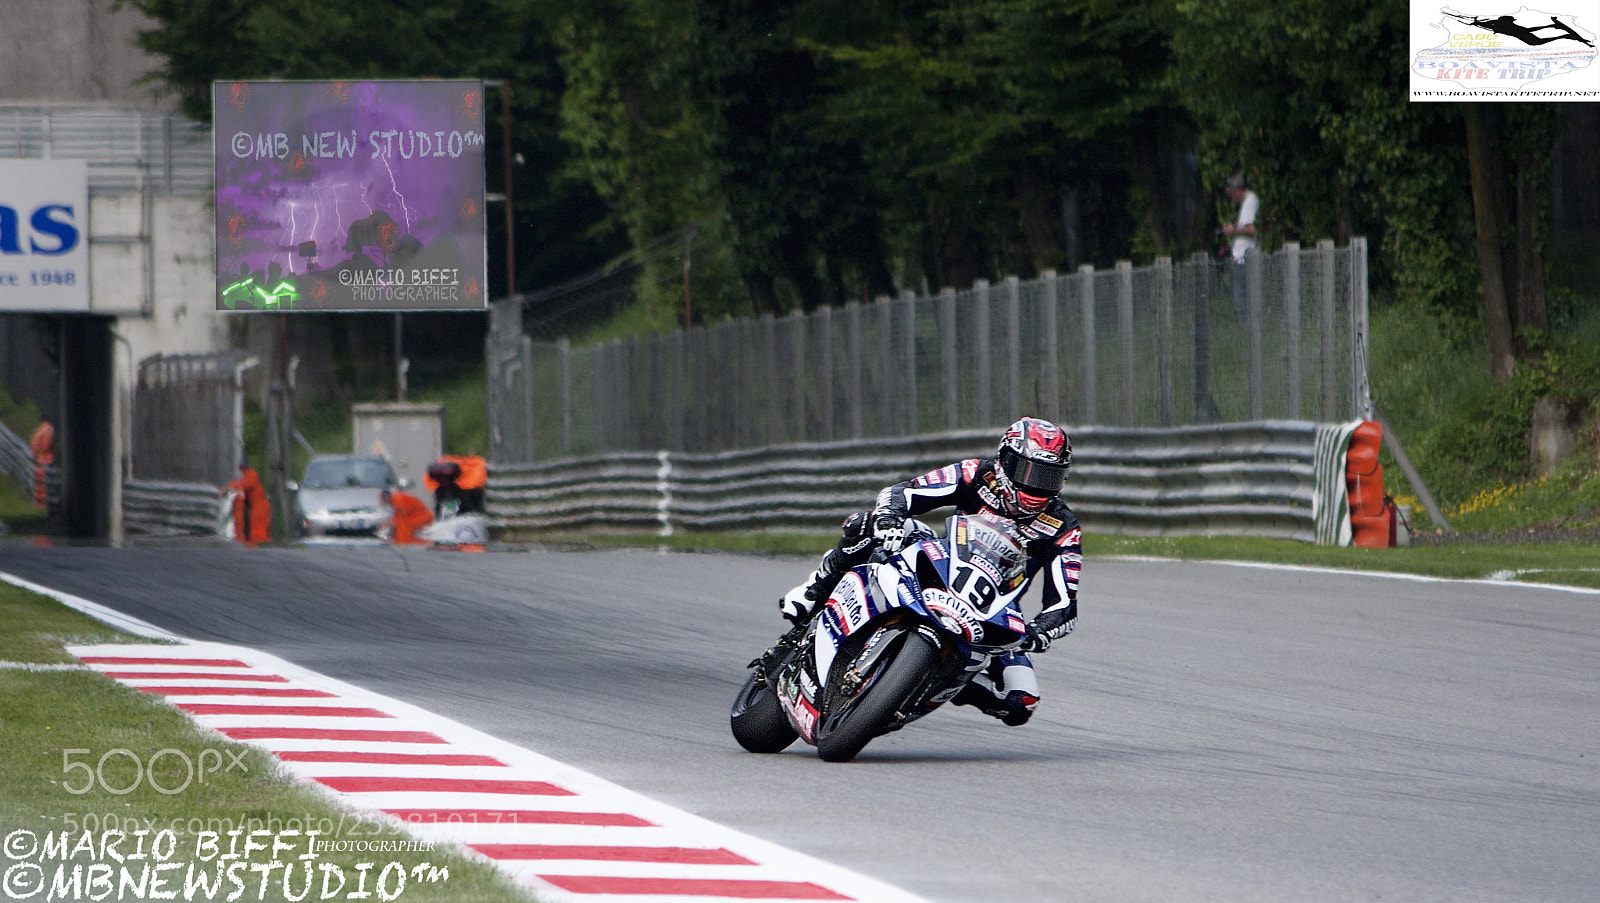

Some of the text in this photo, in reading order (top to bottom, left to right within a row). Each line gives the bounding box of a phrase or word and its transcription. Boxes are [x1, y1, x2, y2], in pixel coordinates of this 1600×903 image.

[302, 130, 357, 159] NEW
[411, 268, 459, 285] BIFFI
[352, 286, 459, 301] PHOTOGRAPHER
[951, 566, 997, 615] 19
